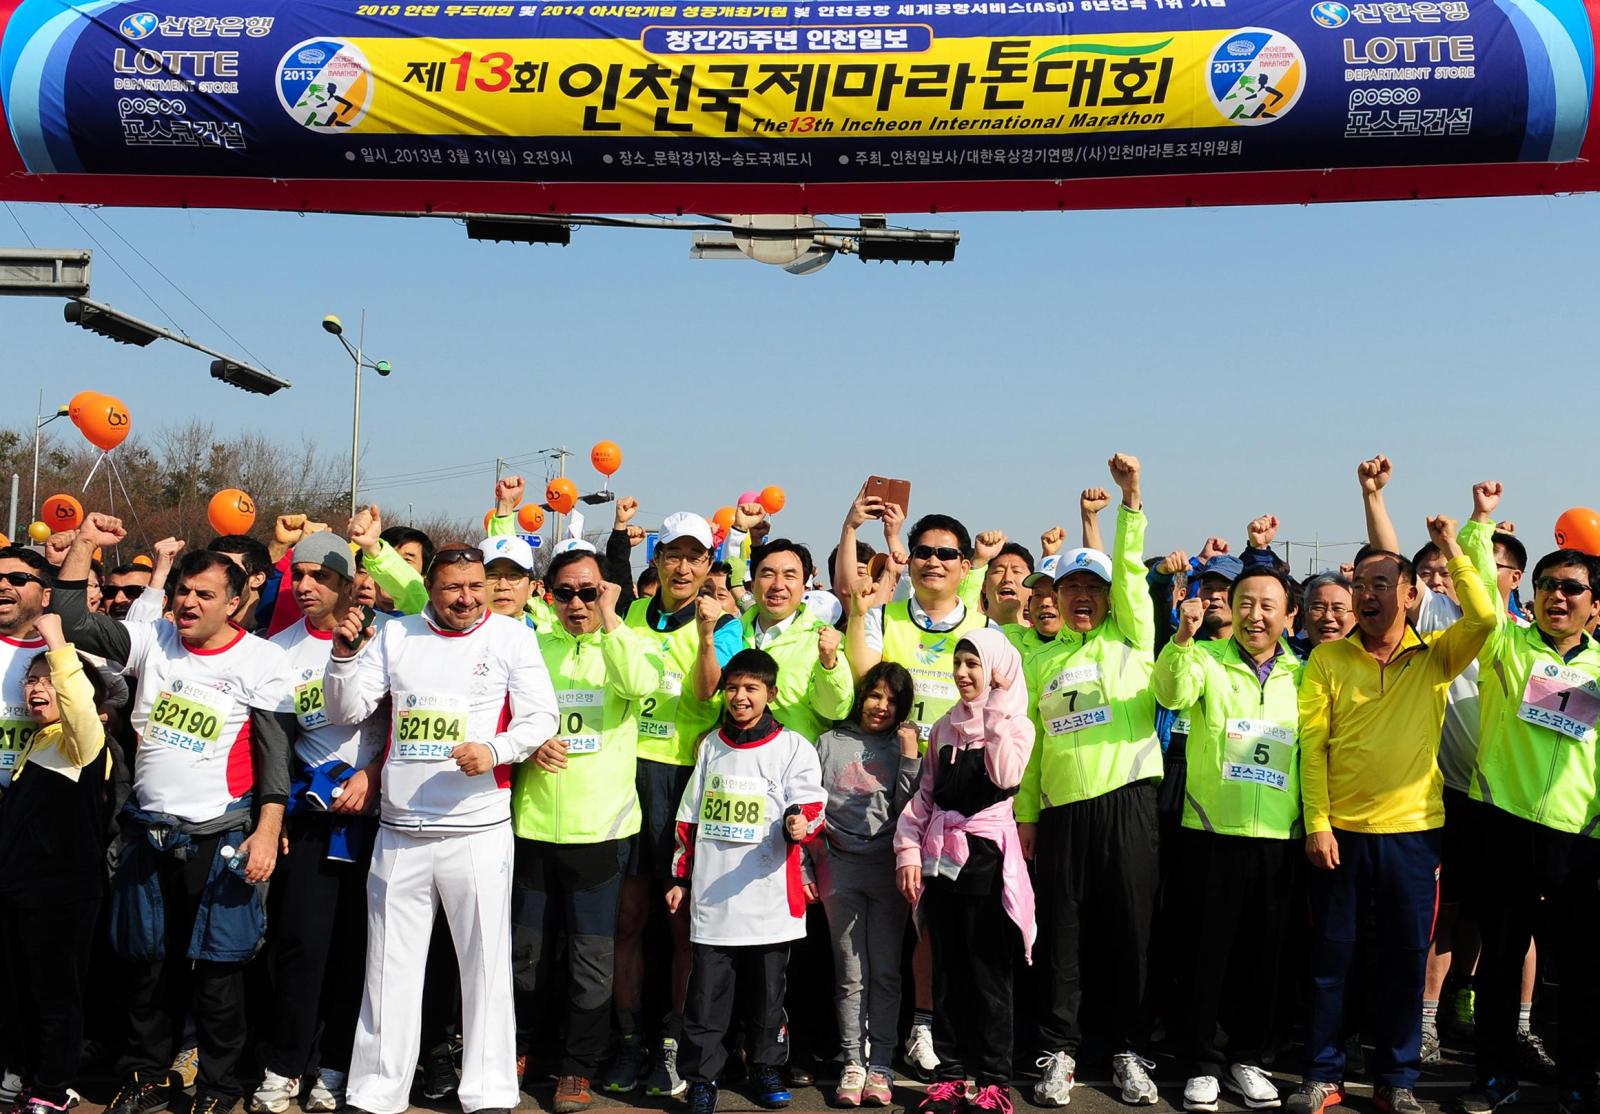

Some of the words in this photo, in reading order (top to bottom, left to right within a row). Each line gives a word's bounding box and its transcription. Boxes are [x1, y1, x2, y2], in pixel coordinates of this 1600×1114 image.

[355, 5, 401, 16] 2013
[404, 5, 440, 16] 인천
[444, 5, 514, 17] 무도대회
[518, 6, 537, 17] 및
[541, 6, 584, 16] 2014
[589, 6, 677, 17] 아시안게임
[682, 6, 787, 17] 성공개최기원
[818, 6, 891, 17] 인천공항
[1351, 1, 1470, 24] 신한은행
[159, 16, 275, 37] 신한은행
[666, 29, 798, 51] 창간25주년
[807, 29, 908, 49] 인천일보
[1343, 36, 1475, 64] LOTTE
[114, 48, 239, 77] LOTTE
[403, 52, 549, 93] 제13회
[1214, 63, 1245, 73] 2013
[284, 70, 314, 81] 2013
[1345, 68, 1430, 81] DEPARTMENT
[1435, 67, 1475, 79] STORE
[114, 77, 196, 93] DEPARTMENT
[198, 81, 239, 94] STORE
[558, 41, 1174, 132] 인천국제마라톤대회
[119, 97, 186, 117] posco
[1350, 88, 1420, 110] posco
[841, 118, 921, 132] Incheon
[929, 115, 1063, 131] International
[1068, 111, 1165, 128] Marathon
[1344, 108, 1472, 138] 포스코건설
[122, 118, 247, 149] 포스코건설
[361, 148, 442, 164] 일시_2013년
[447, 149, 470, 164] 3월
[475, 149, 517, 166] 31(일)
[523, 150, 573, 166] 오전9시
[300, 687, 324, 714] 52
[641, 698, 657, 718] 2
[1062, 690, 1078, 713] 7
[1558, 691, 1571, 713] 1
[154, 700, 217, 738] 52190
[400, 717, 460, 741] 52194
[1052, 710, 1105, 733] 포스코건설
[1526, 708, 1586, 738] 포스코건설
[151, 726, 206, 753] 포스코건설
[400, 744, 454, 757] 포스코건설
[1253, 743, 1270, 765] 5
[1231, 766, 1285, 786] 포스코건설
[704, 798, 759, 824] 52198
[704, 823, 756, 840] 포스코건설
